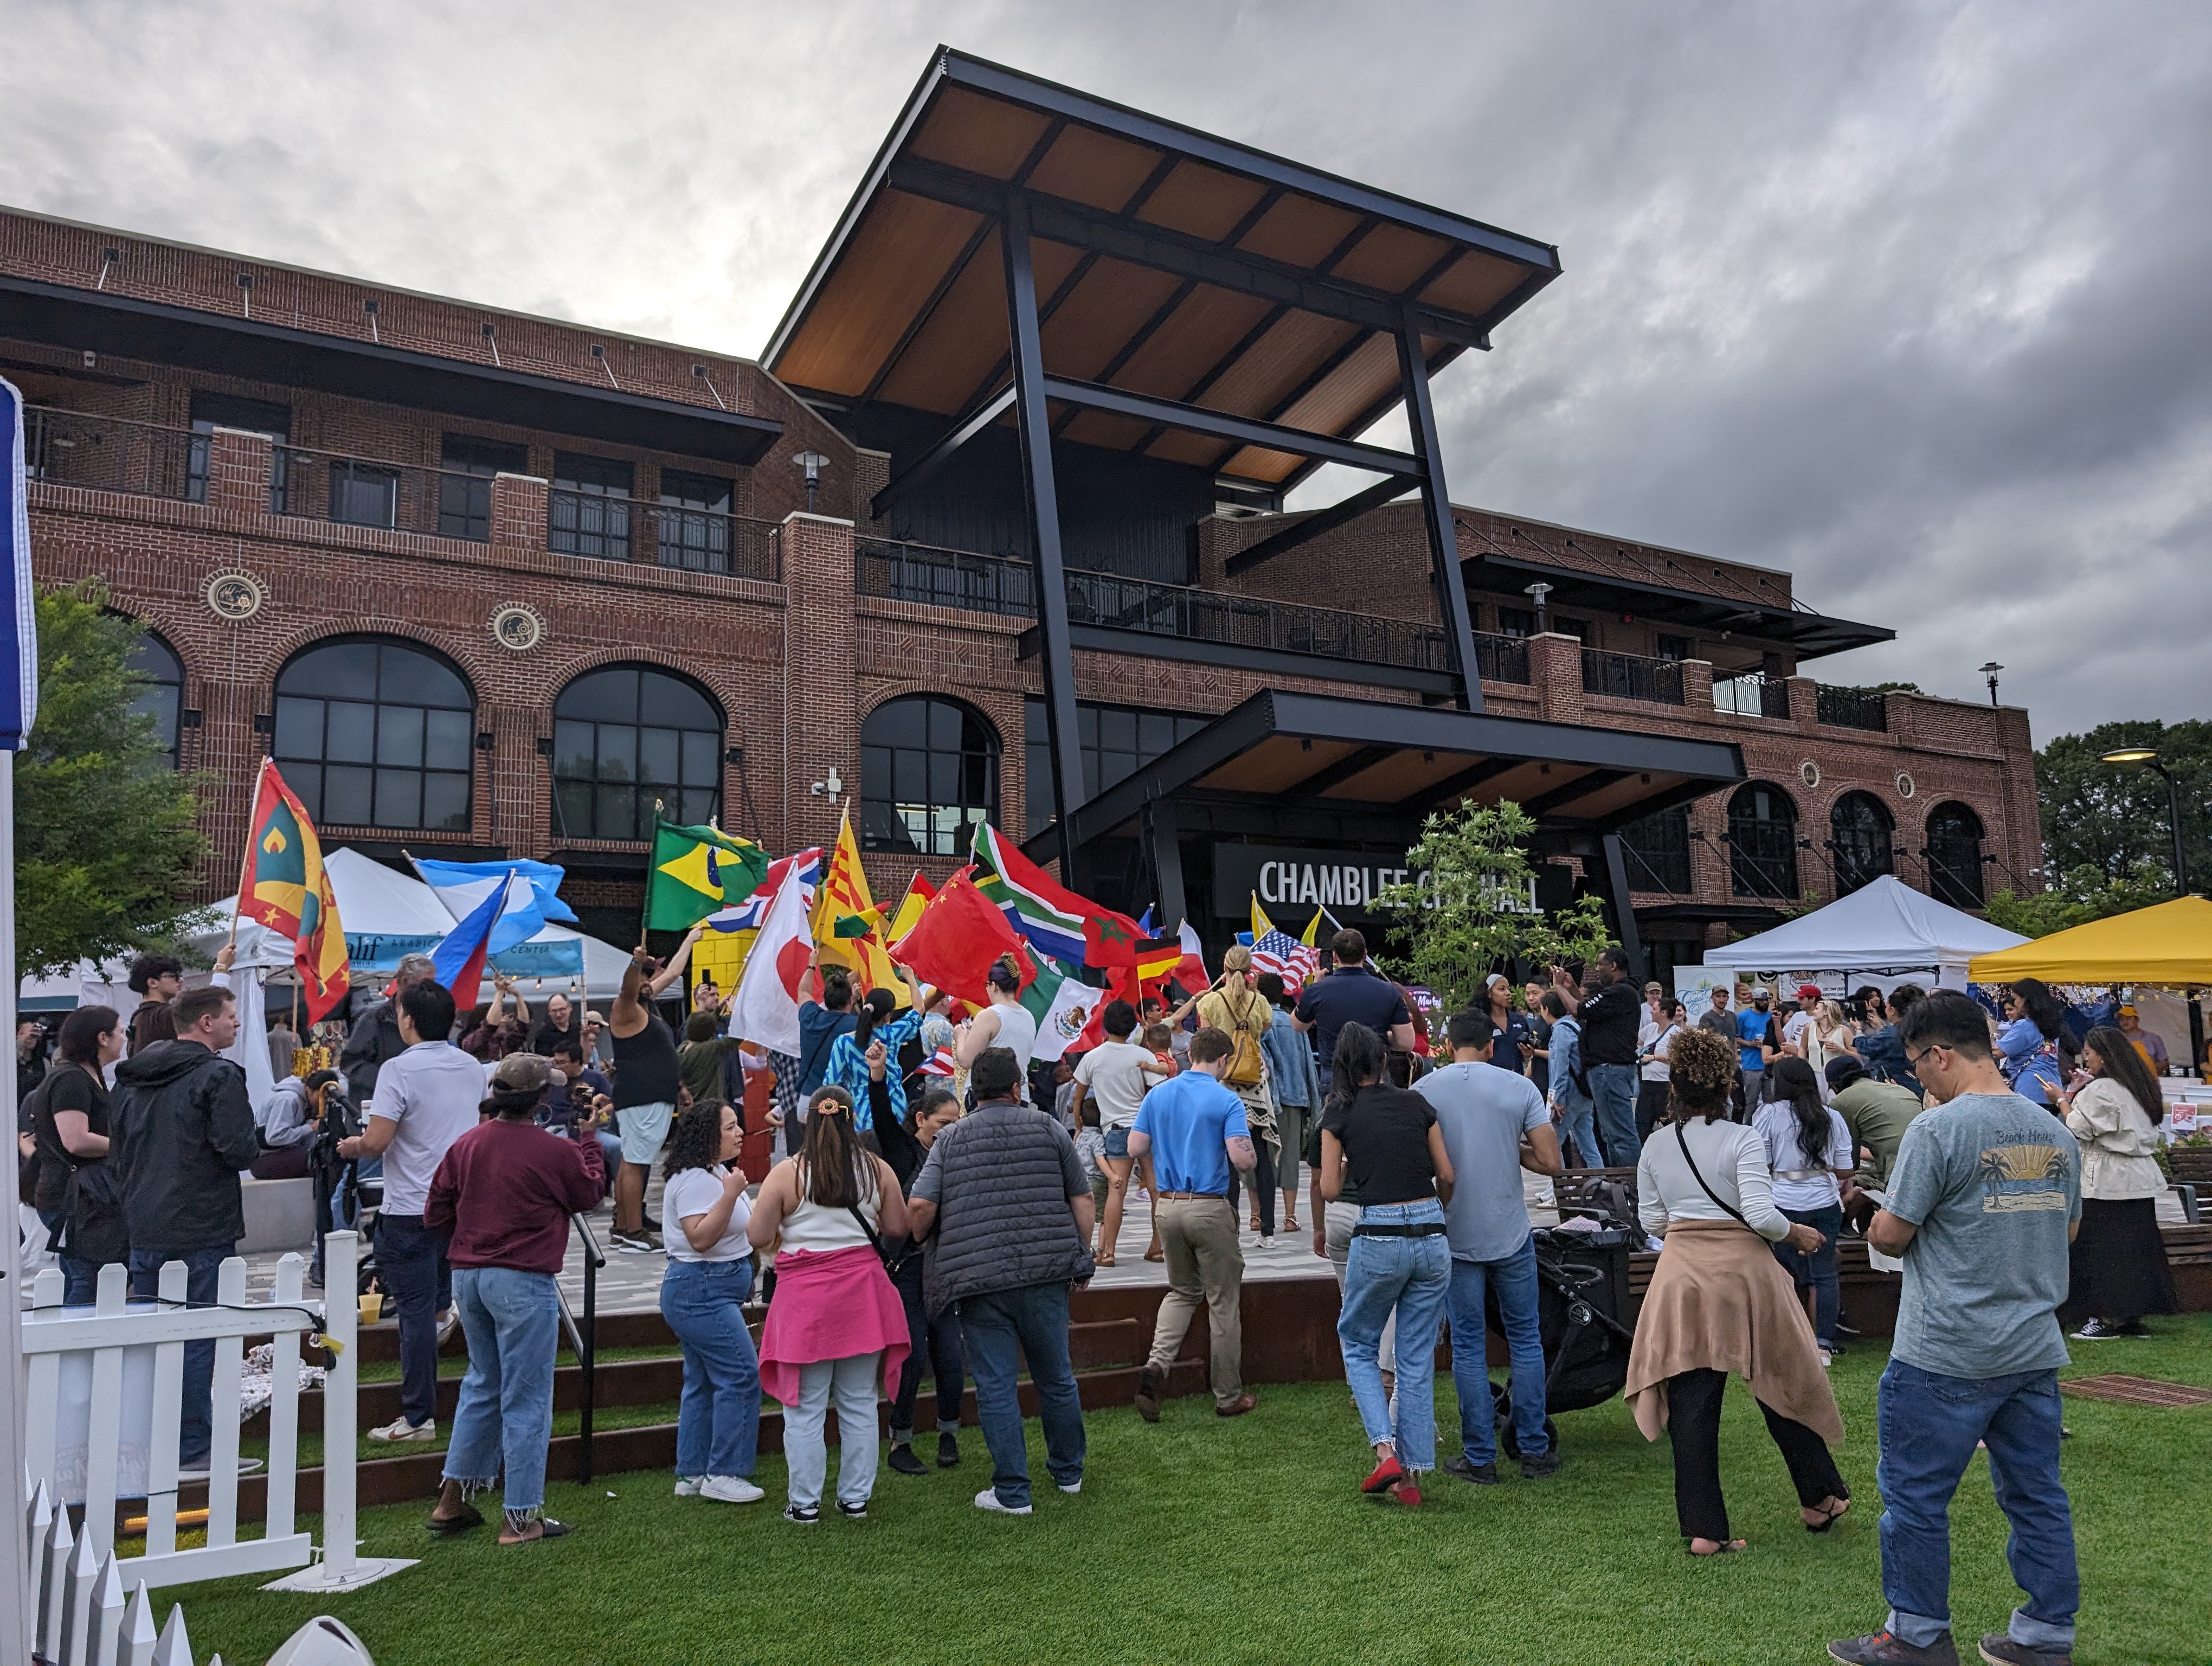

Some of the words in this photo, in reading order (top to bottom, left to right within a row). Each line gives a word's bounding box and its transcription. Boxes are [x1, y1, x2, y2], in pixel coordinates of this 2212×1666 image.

[1259, 861, 1409, 908] CHAMBLEE
[391, 939, 433, 947] ARABIC
[511, 945, 550, 954] CENTER
[1996, 1130, 2025, 1144] Beach
[2028, 1129, 2057, 1144] House
